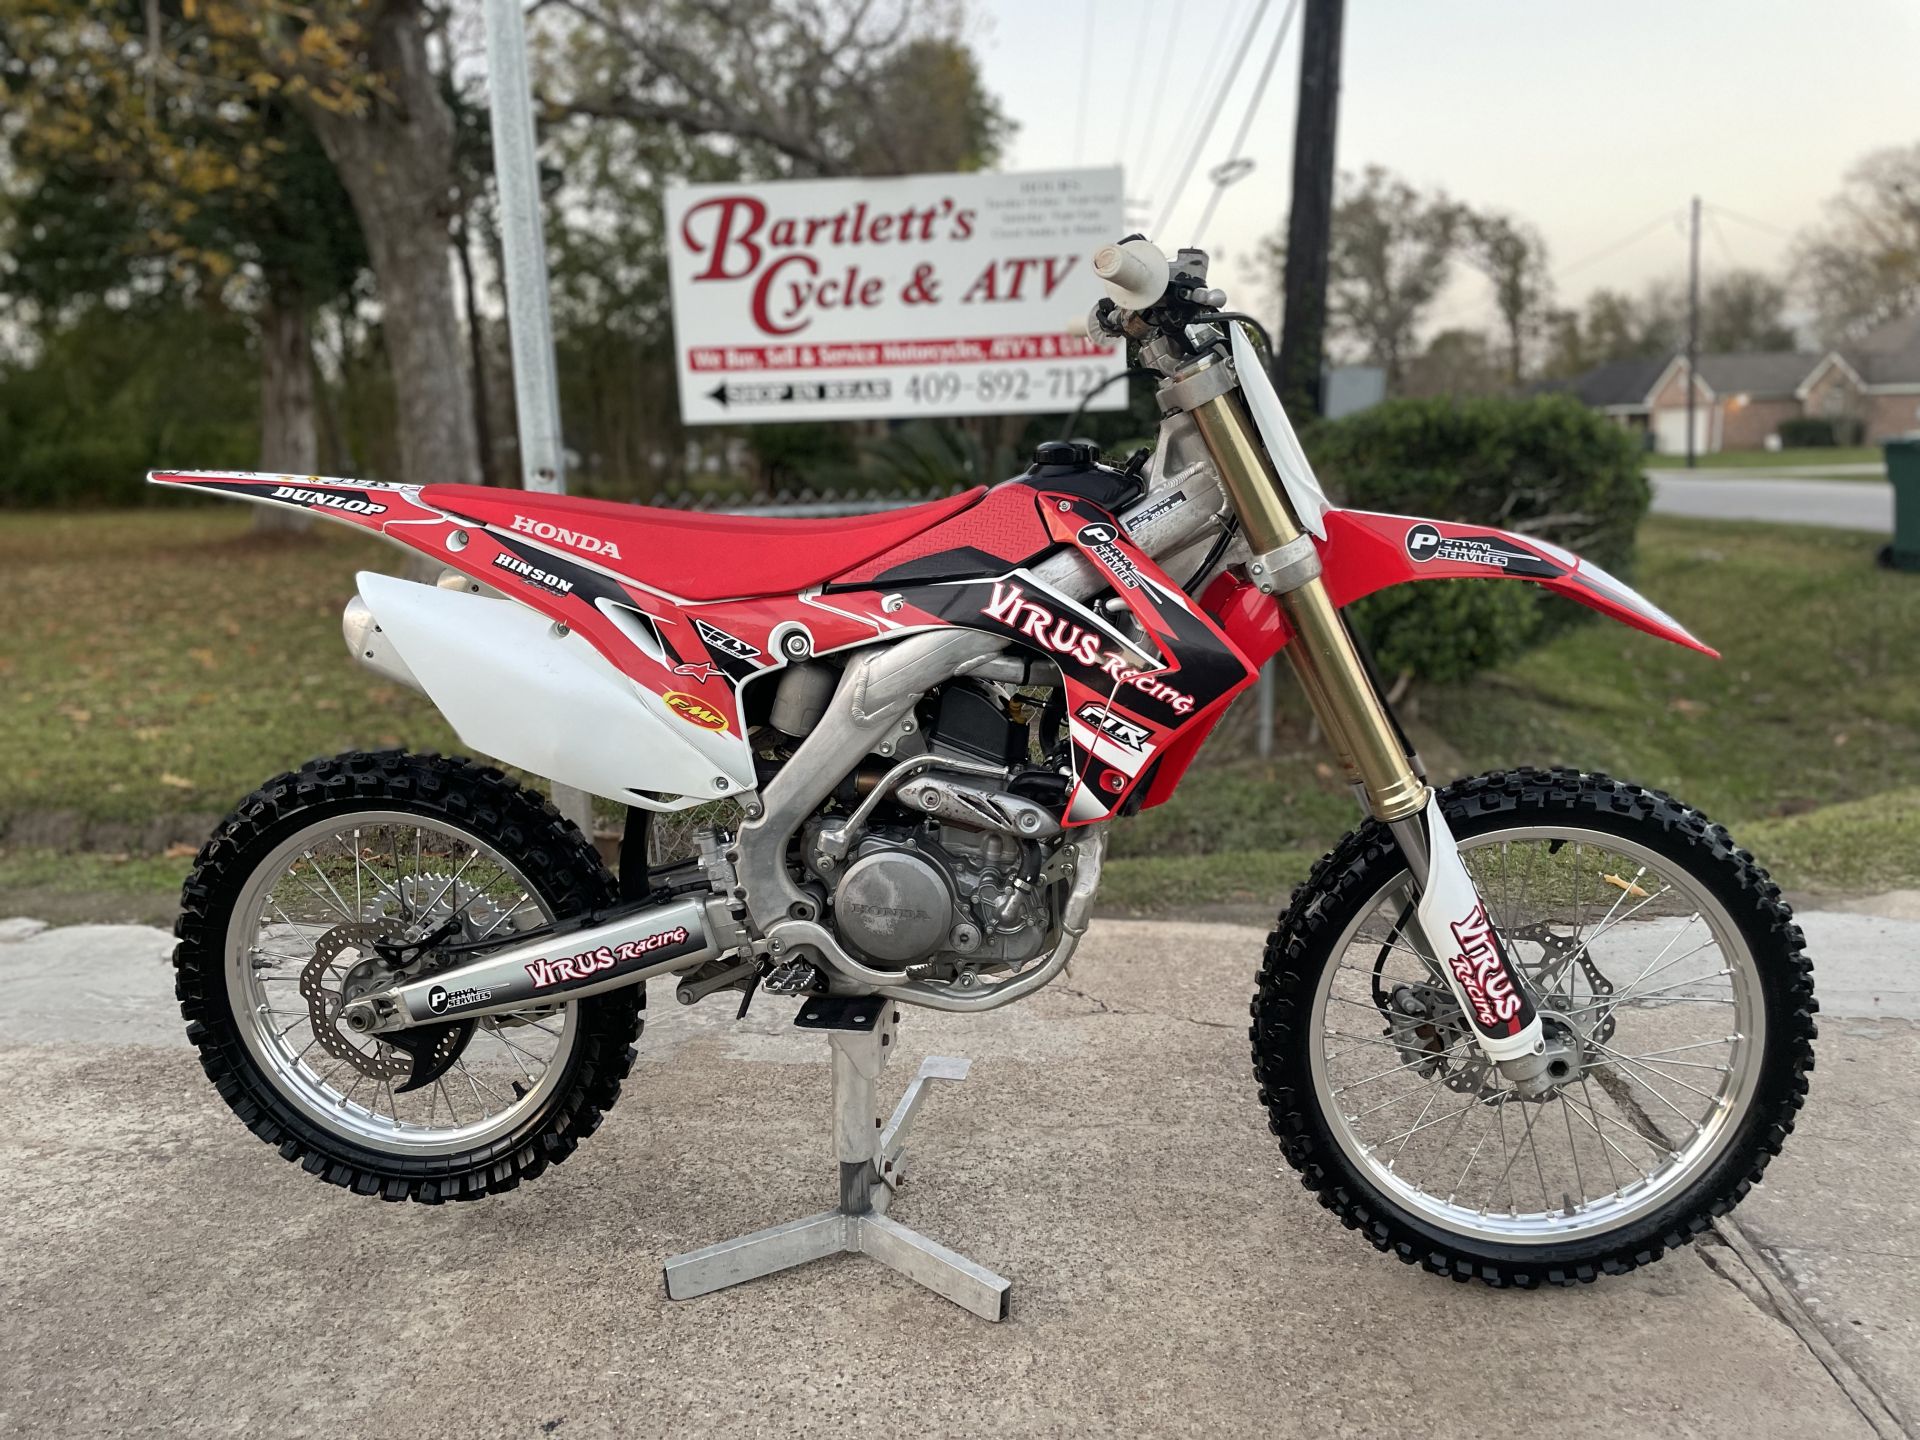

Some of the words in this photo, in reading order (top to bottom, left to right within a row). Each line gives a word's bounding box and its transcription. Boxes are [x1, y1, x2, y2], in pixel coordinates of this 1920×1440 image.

[681, 194, 976, 282] Bartlett's
[752, 253, 882, 336] Cycle
[900, 262, 940, 306] &
[959, 254, 1079, 304] ATV
[693, 349, 721, 367] We
[767, 347, 794, 366] Sell
[819, 344, 877, 366] Service
[271, 486, 387, 515] DUNLOP
[1150, 505, 1169, 520] 2016
[510, 515, 622, 560] HONDA
[494, 553, 574, 592] HINSON
[1092, 545, 1139, 589] SERVICES
[1437, 550, 1508, 567] SERVICES
[704, 628, 760, 657] FLY
[980, 582, 1100, 667] VIRUS
[665, 697, 726, 725] FMF
[525, 946, 616, 988] VIRUS
[1450, 905, 1522, 1021] VIRUS
[448, 991, 492, 1009] SERVICES
